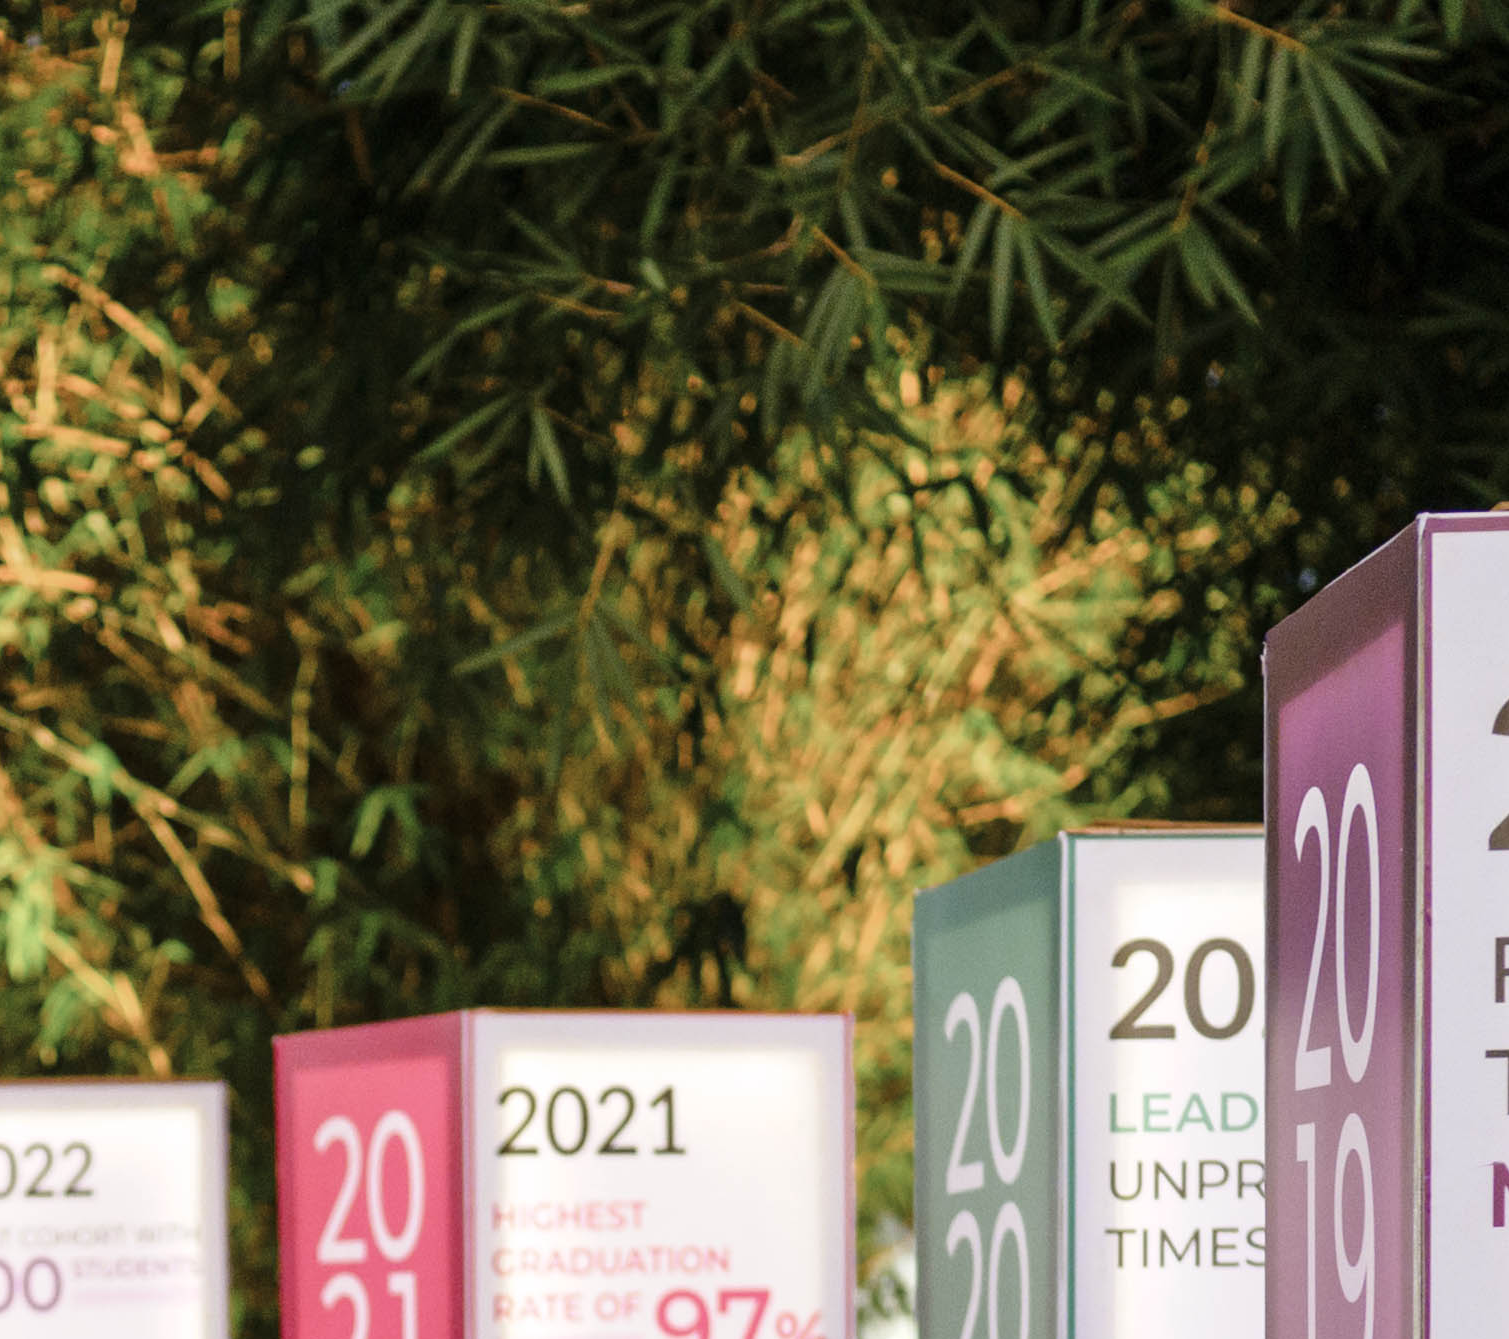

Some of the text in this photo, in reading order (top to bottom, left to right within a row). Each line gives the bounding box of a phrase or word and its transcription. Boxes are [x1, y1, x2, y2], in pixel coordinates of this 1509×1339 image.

[1294, 763, 1379, 1091] 20
[1109, 936, 1265, 1040] 20
[496, 1085, 686, 1156] 2021
[945, 975, 1030, 1195] 20
[313, 1109, 425, 1264] 20
[492, 1201, 648, 1231] HIGHEST
[492, 1246, 731, 1277] GRADUATION
[1105, 1228, 1265, 1269] TIMES
[493, 1292, 582, 1323] RATE
[593, 1290, 642, 1322] OF
